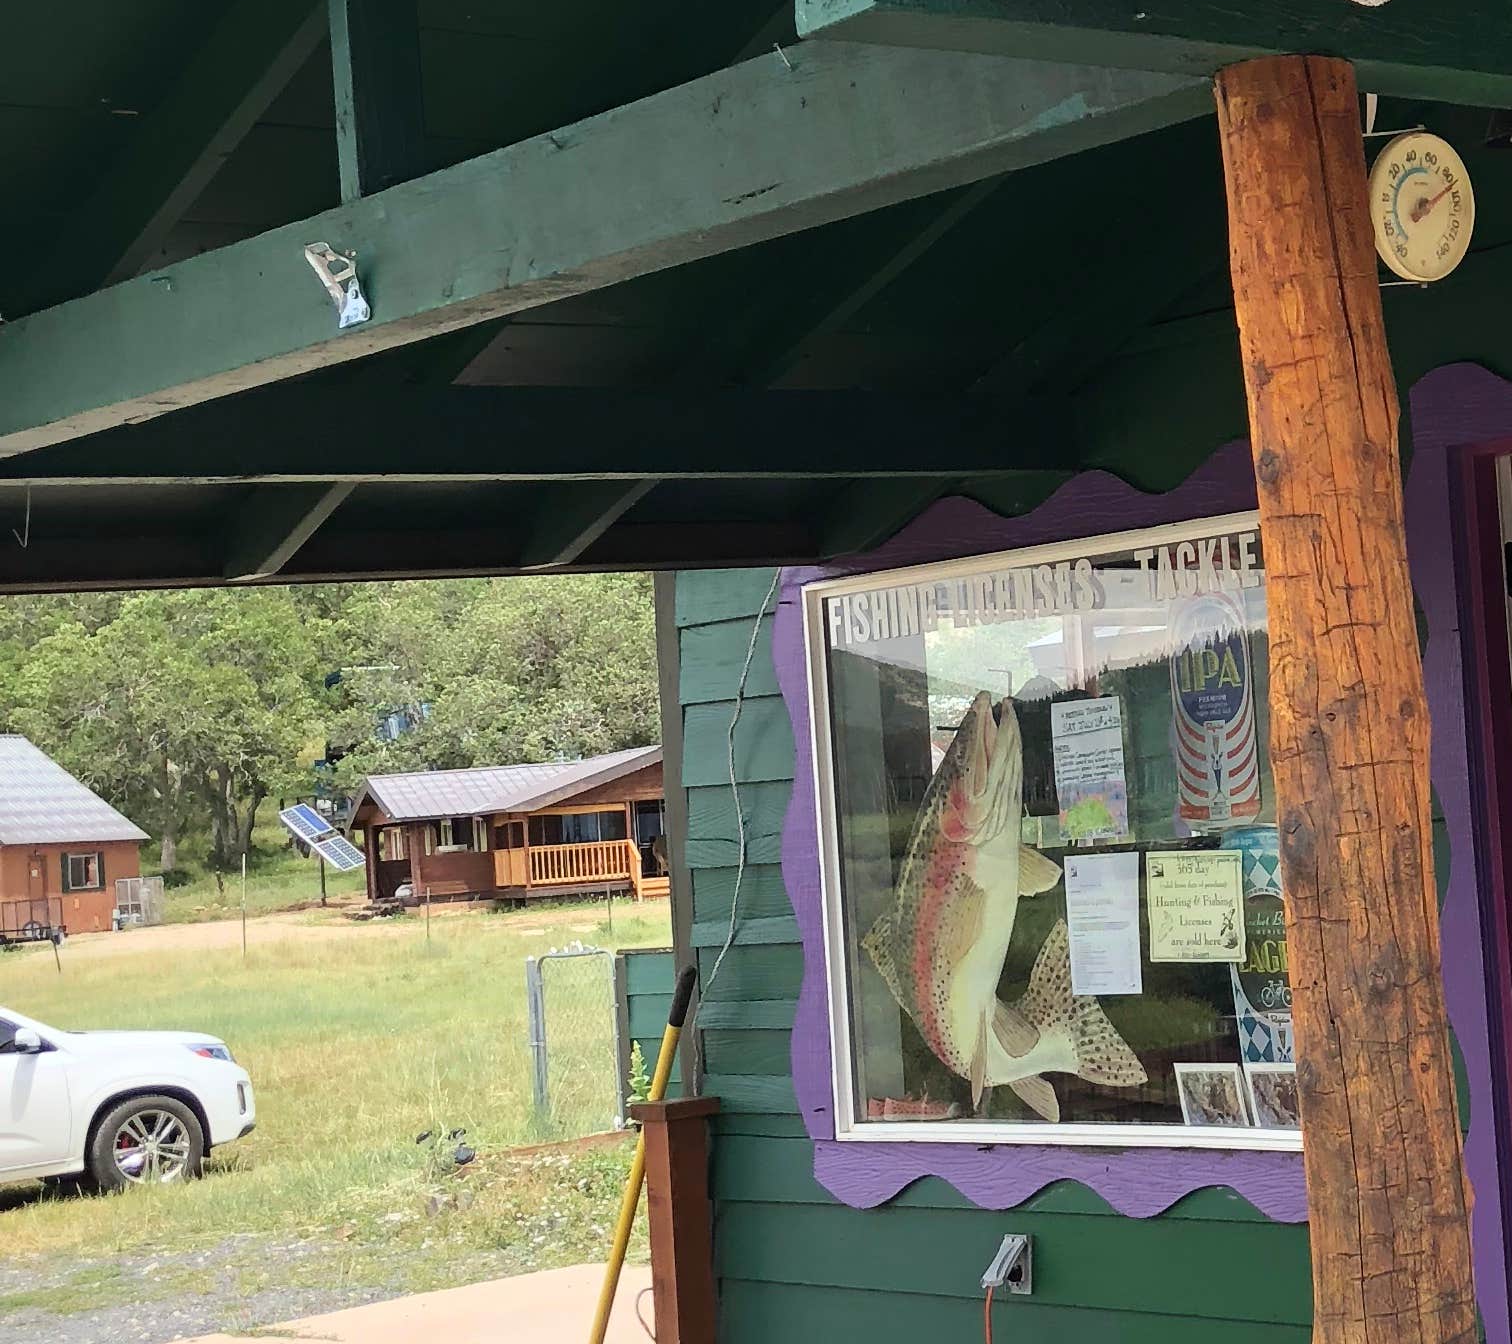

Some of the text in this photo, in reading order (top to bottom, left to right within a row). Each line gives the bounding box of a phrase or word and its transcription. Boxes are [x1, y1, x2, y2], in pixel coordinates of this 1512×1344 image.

[1406, 150, 1417, 162] 40
[1425, 151, 1438, 165] 60
[1389, 163, 1400, 179] 20
[829, 585, 937, 647] FISHING
[952, 558, 1094, 630] LICENSES
[1134, 533, 1260, 601] TACKLE
[1181, 646, 1242, 692] IPA
[1177, 861, 1209, 876] 365 day
[1156, 895, 1191, 908] Hunting
[1203, 893, 1233, 908] Fishing
[1180, 915, 1212, 926] Licenses
[1186, 931, 1202, 946] sold
[1204, 931, 1221, 946] here
